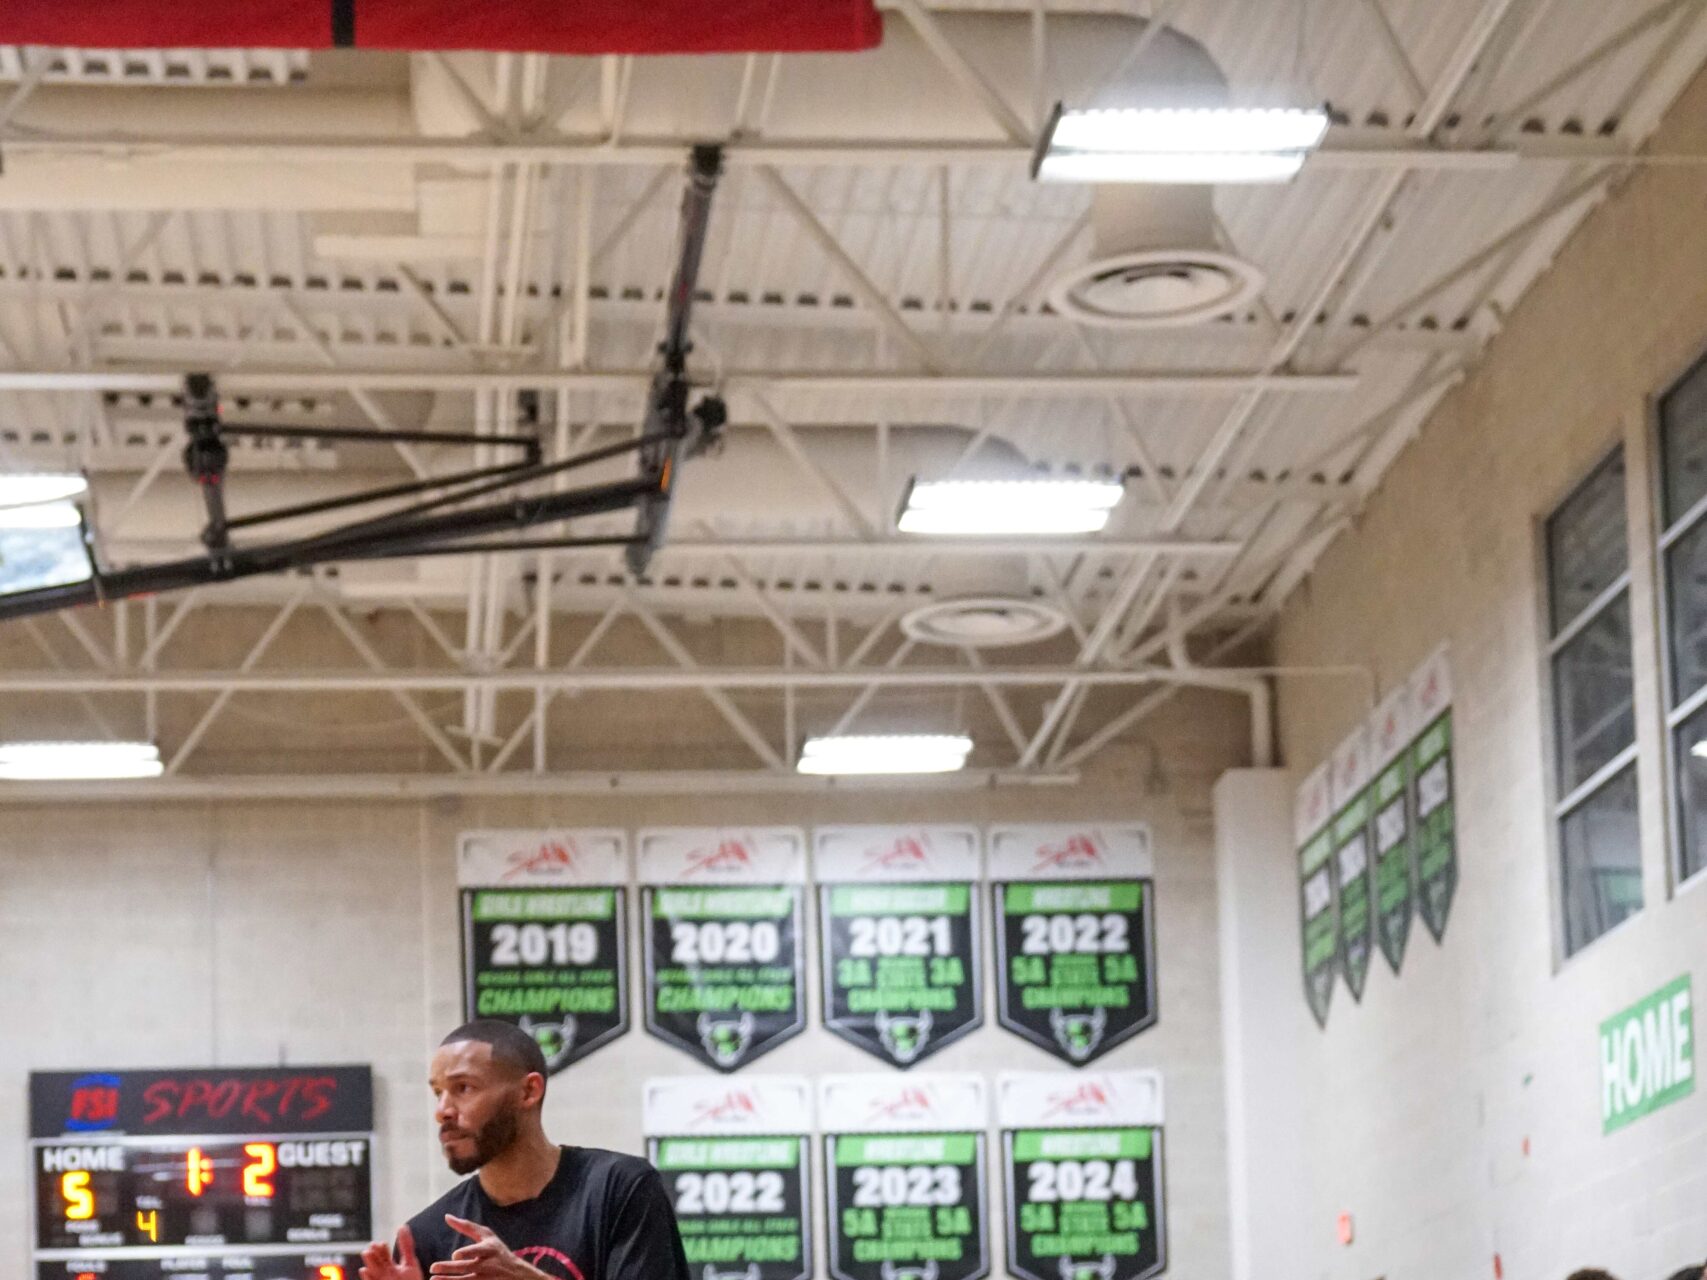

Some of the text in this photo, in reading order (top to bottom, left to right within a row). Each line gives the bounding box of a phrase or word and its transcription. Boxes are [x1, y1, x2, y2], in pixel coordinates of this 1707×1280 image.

[489, 922, 598, 966] 2019
[671, 920, 779, 963] 2020
[849, 916, 951, 956] 2021
[1021, 914, 1130, 954] 2022
[477, 986, 616, 1015] CHAMPIONS
[656, 984, 792, 1012] CHAMPIONS
[1600, 988, 1692, 1121] HOME
[142, 1075, 338, 1125] SPORTS
[43, 1146, 125, 1172] HOME
[242, 1142, 276, 1198] 2
[277, 1140, 365, 1167] GUEST
[60, 1169, 95, 1220] 5
[674, 1170, 786, 1213] 2022
[852, 1164, 962, 1208] 2023
[1027, 1158, 1138, 1202] 2024
[135, 1209, 160, 1243] 4
[681, 1236, 799, 1263] HAMPIONS
